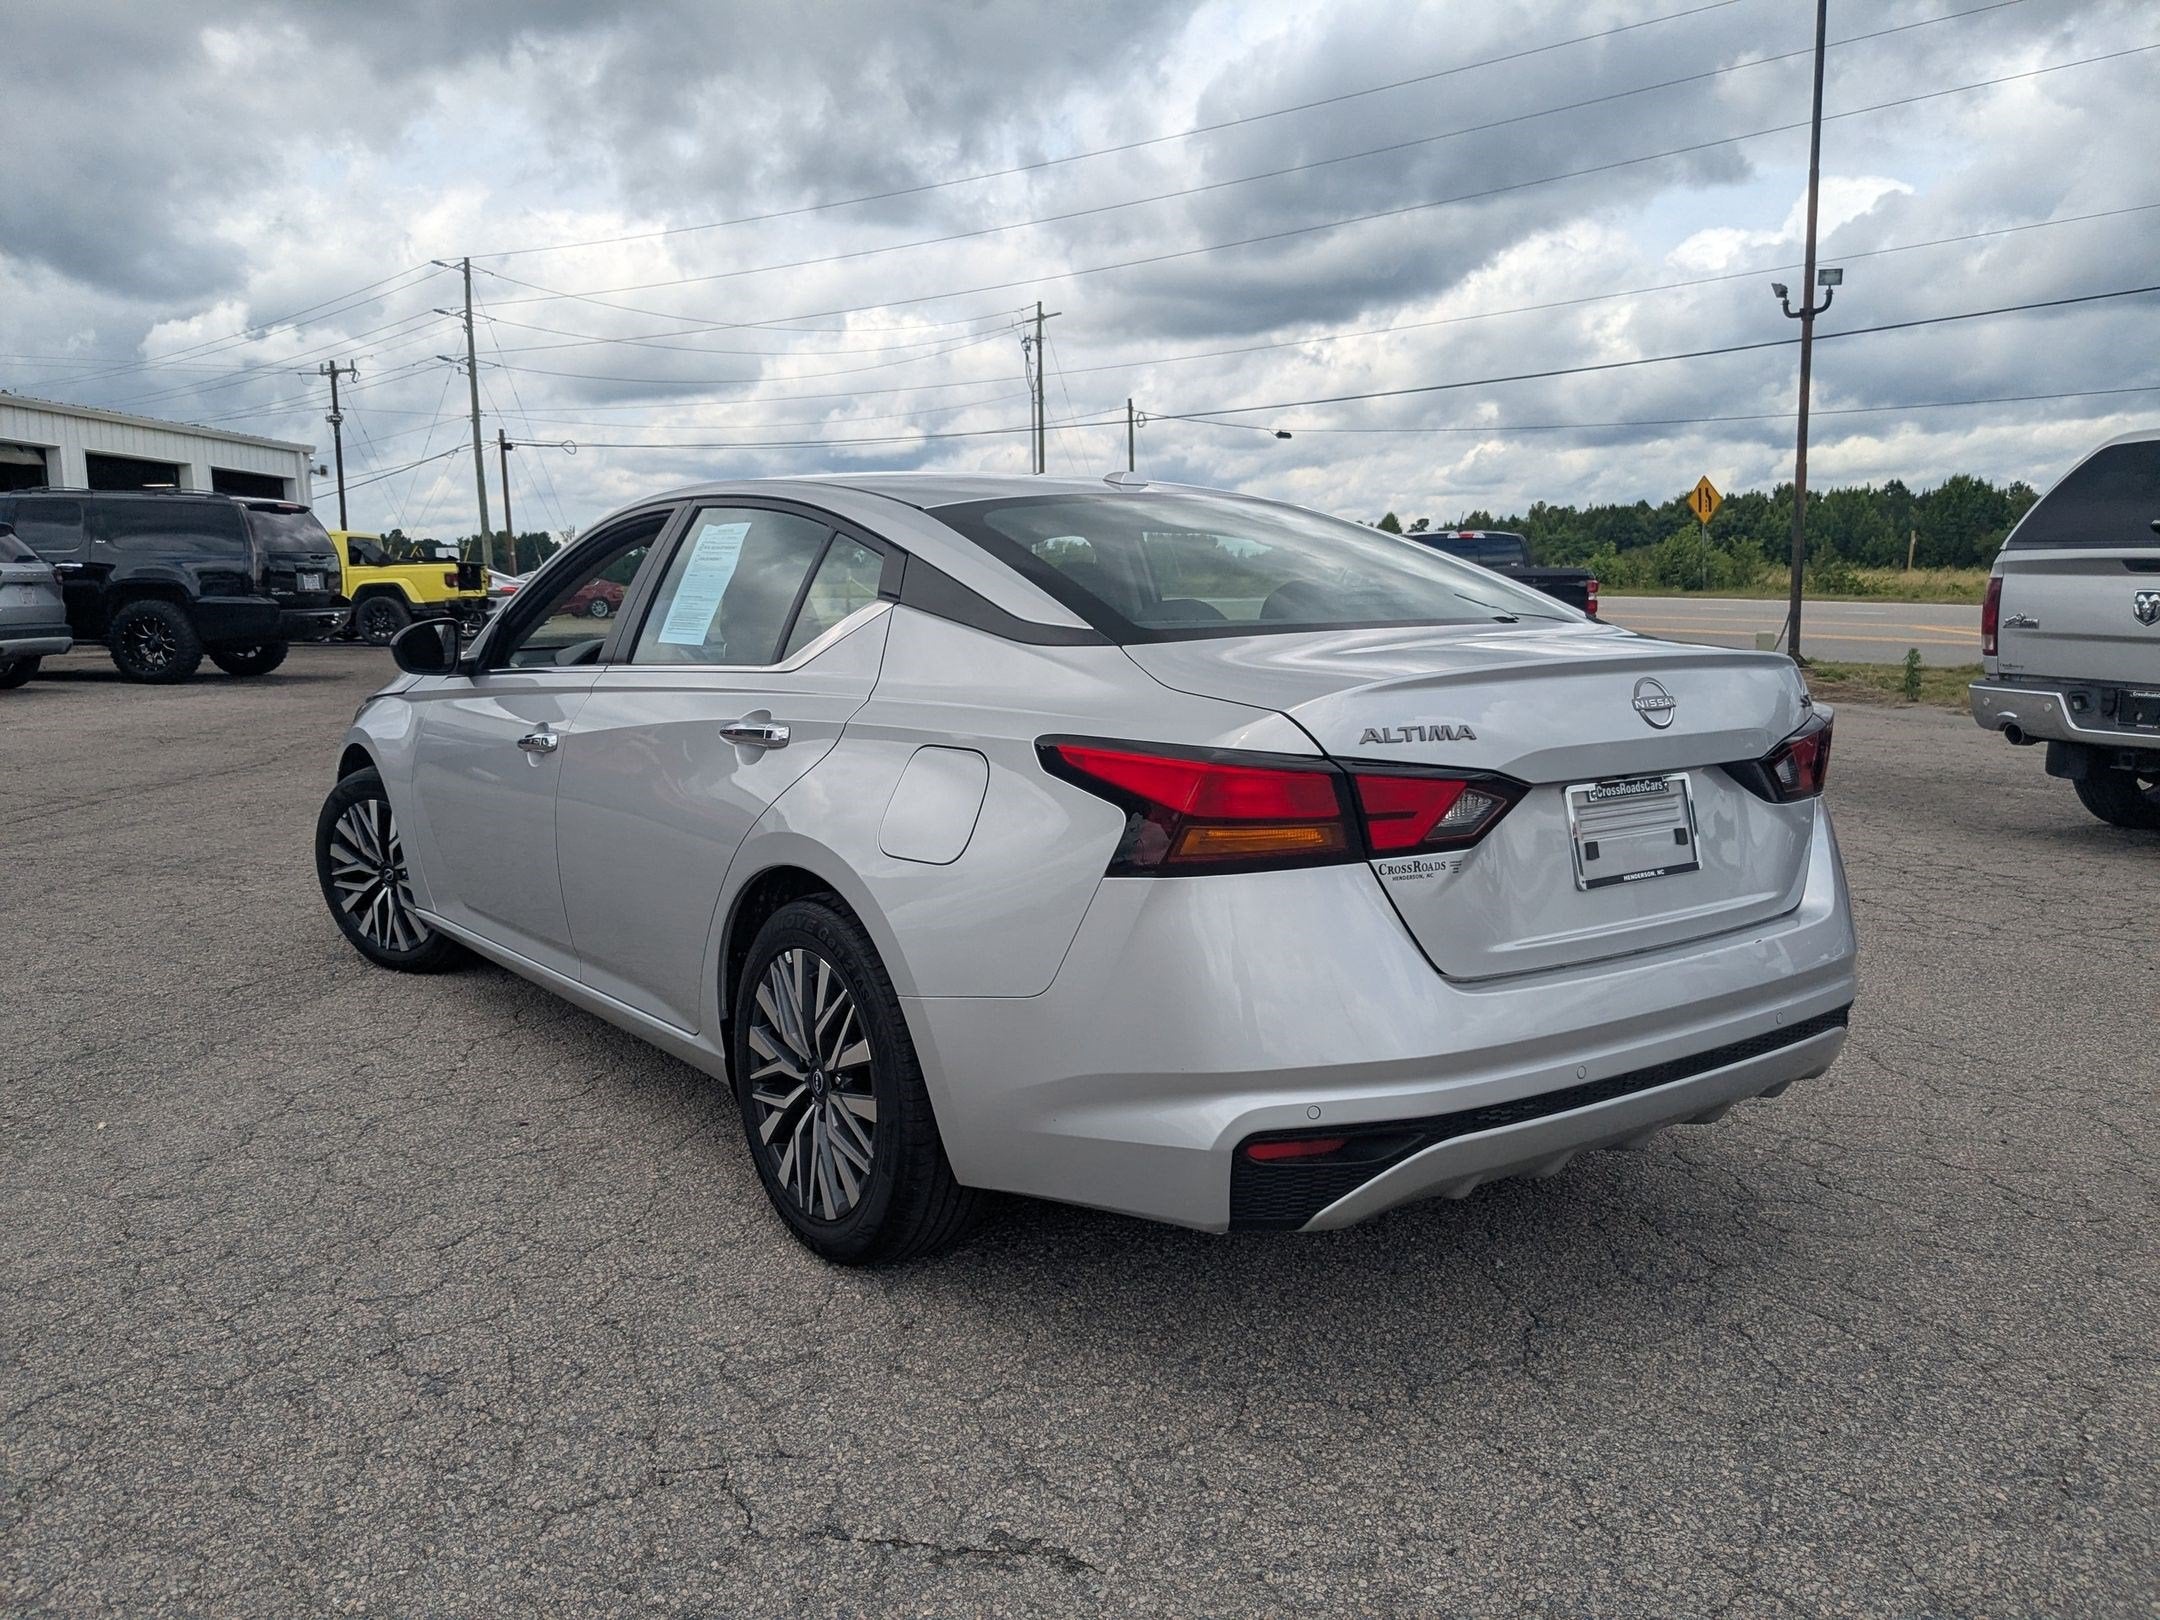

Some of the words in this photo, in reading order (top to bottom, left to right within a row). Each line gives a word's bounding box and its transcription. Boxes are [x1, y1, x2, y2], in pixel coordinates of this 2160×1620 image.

[1635, 698, 1676, 708] NISSAN
[1359, 725, 1477, 745] ALTIMA
[1596, 780, 1663, 798] CrossRoadsCars
